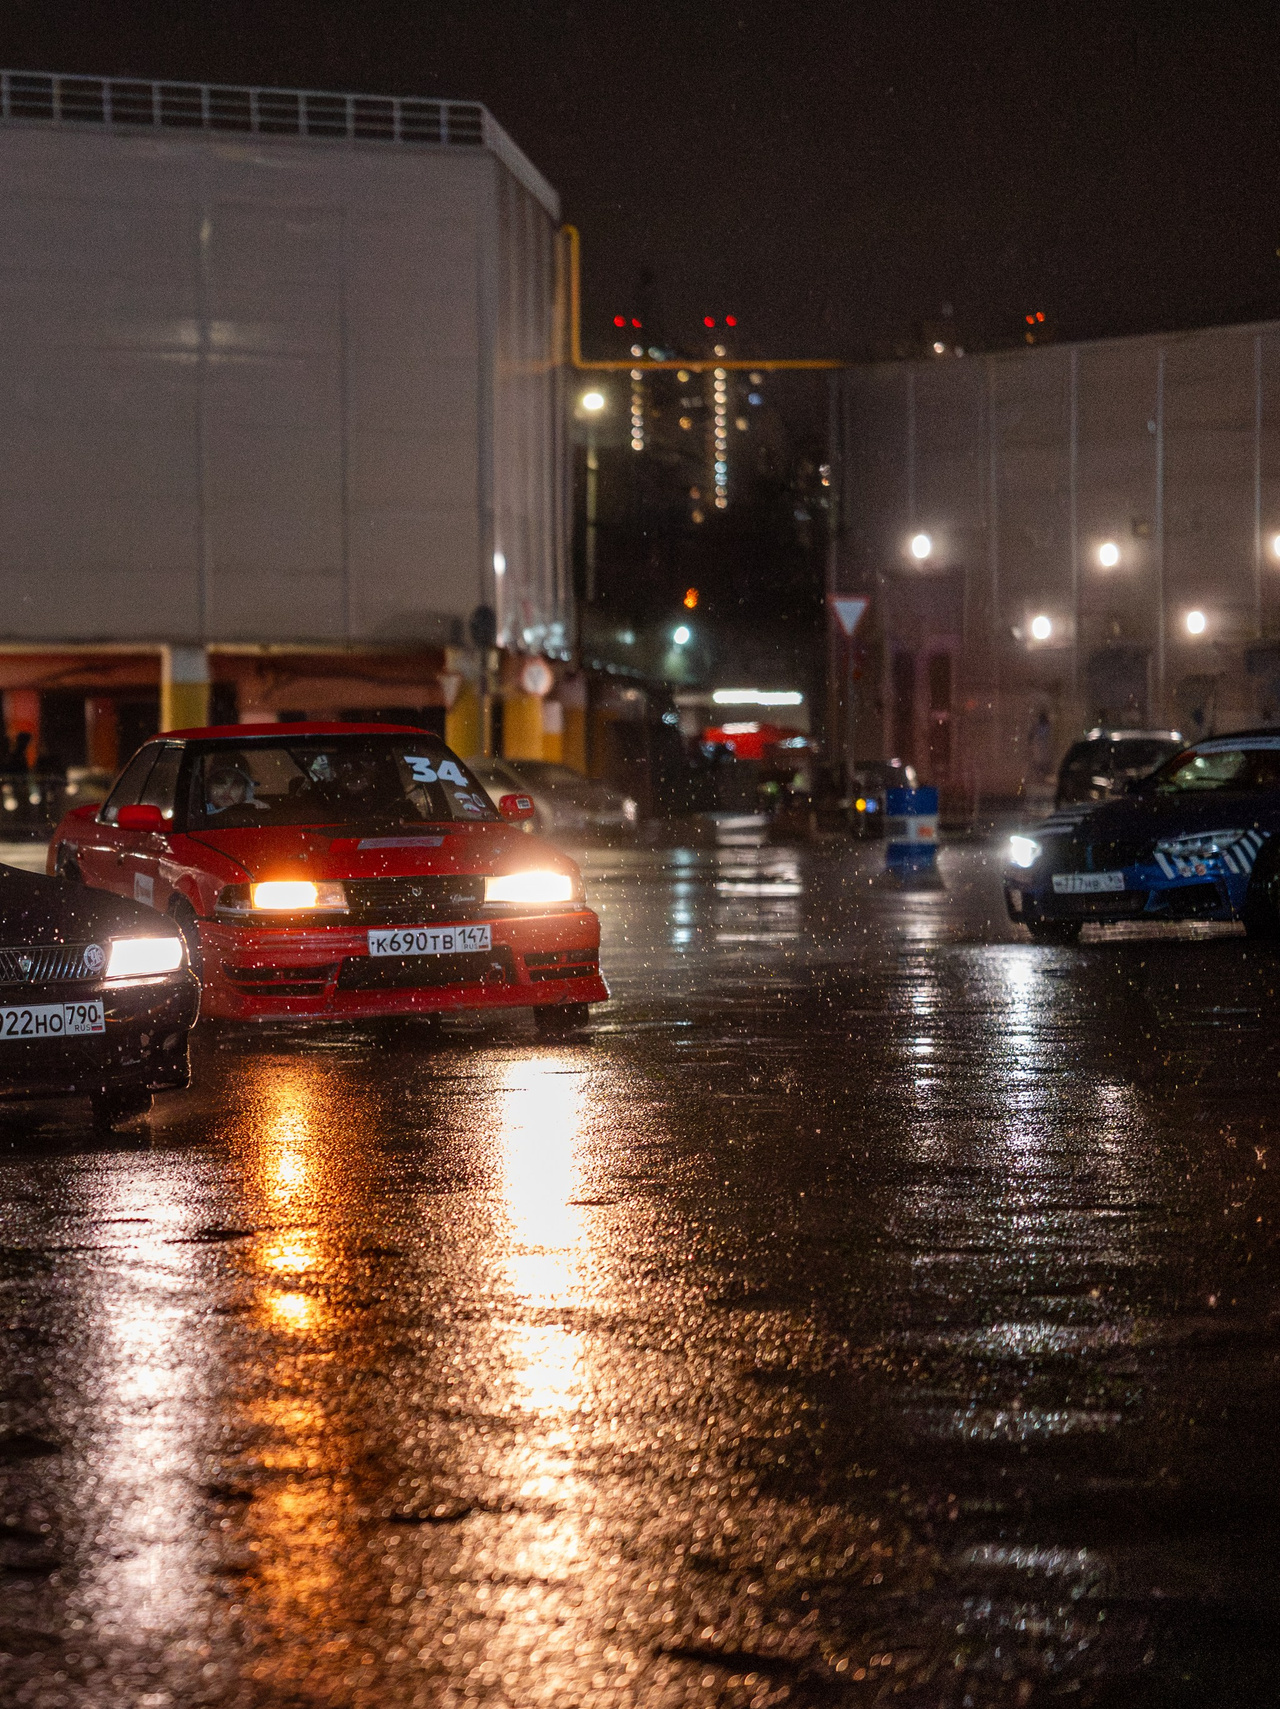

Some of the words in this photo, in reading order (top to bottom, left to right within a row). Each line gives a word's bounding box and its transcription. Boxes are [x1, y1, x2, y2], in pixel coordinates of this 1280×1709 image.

[404, 755, 468, 787] 34
[376, 931, 454, 953] К690ТВ
[65, 1004, 98, 1025] 790
[74, 1024, 91, 1032] RUS
